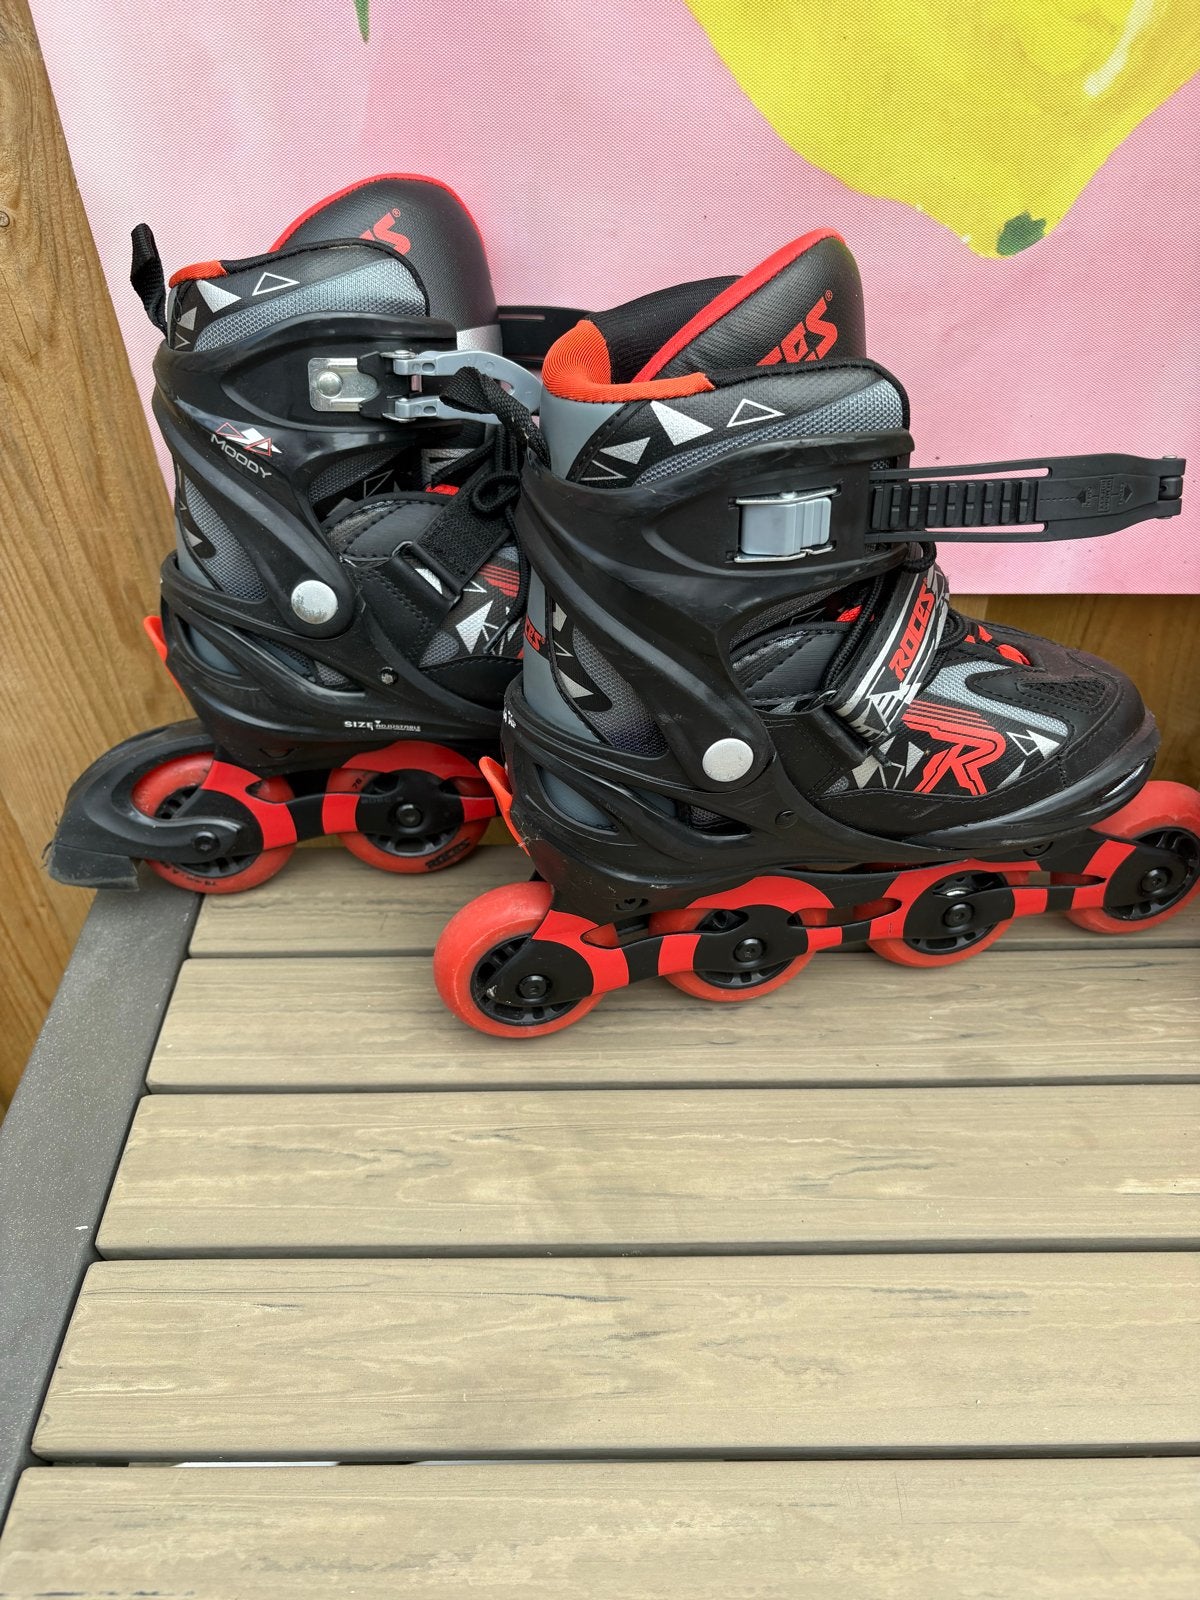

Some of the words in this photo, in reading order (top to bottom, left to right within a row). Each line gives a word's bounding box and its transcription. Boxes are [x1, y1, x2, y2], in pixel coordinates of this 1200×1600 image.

[210, 433, 272, 479] MOODY
[888, 583, 935, 682] ROCES
[343, 720, 374, 731] SIZE
